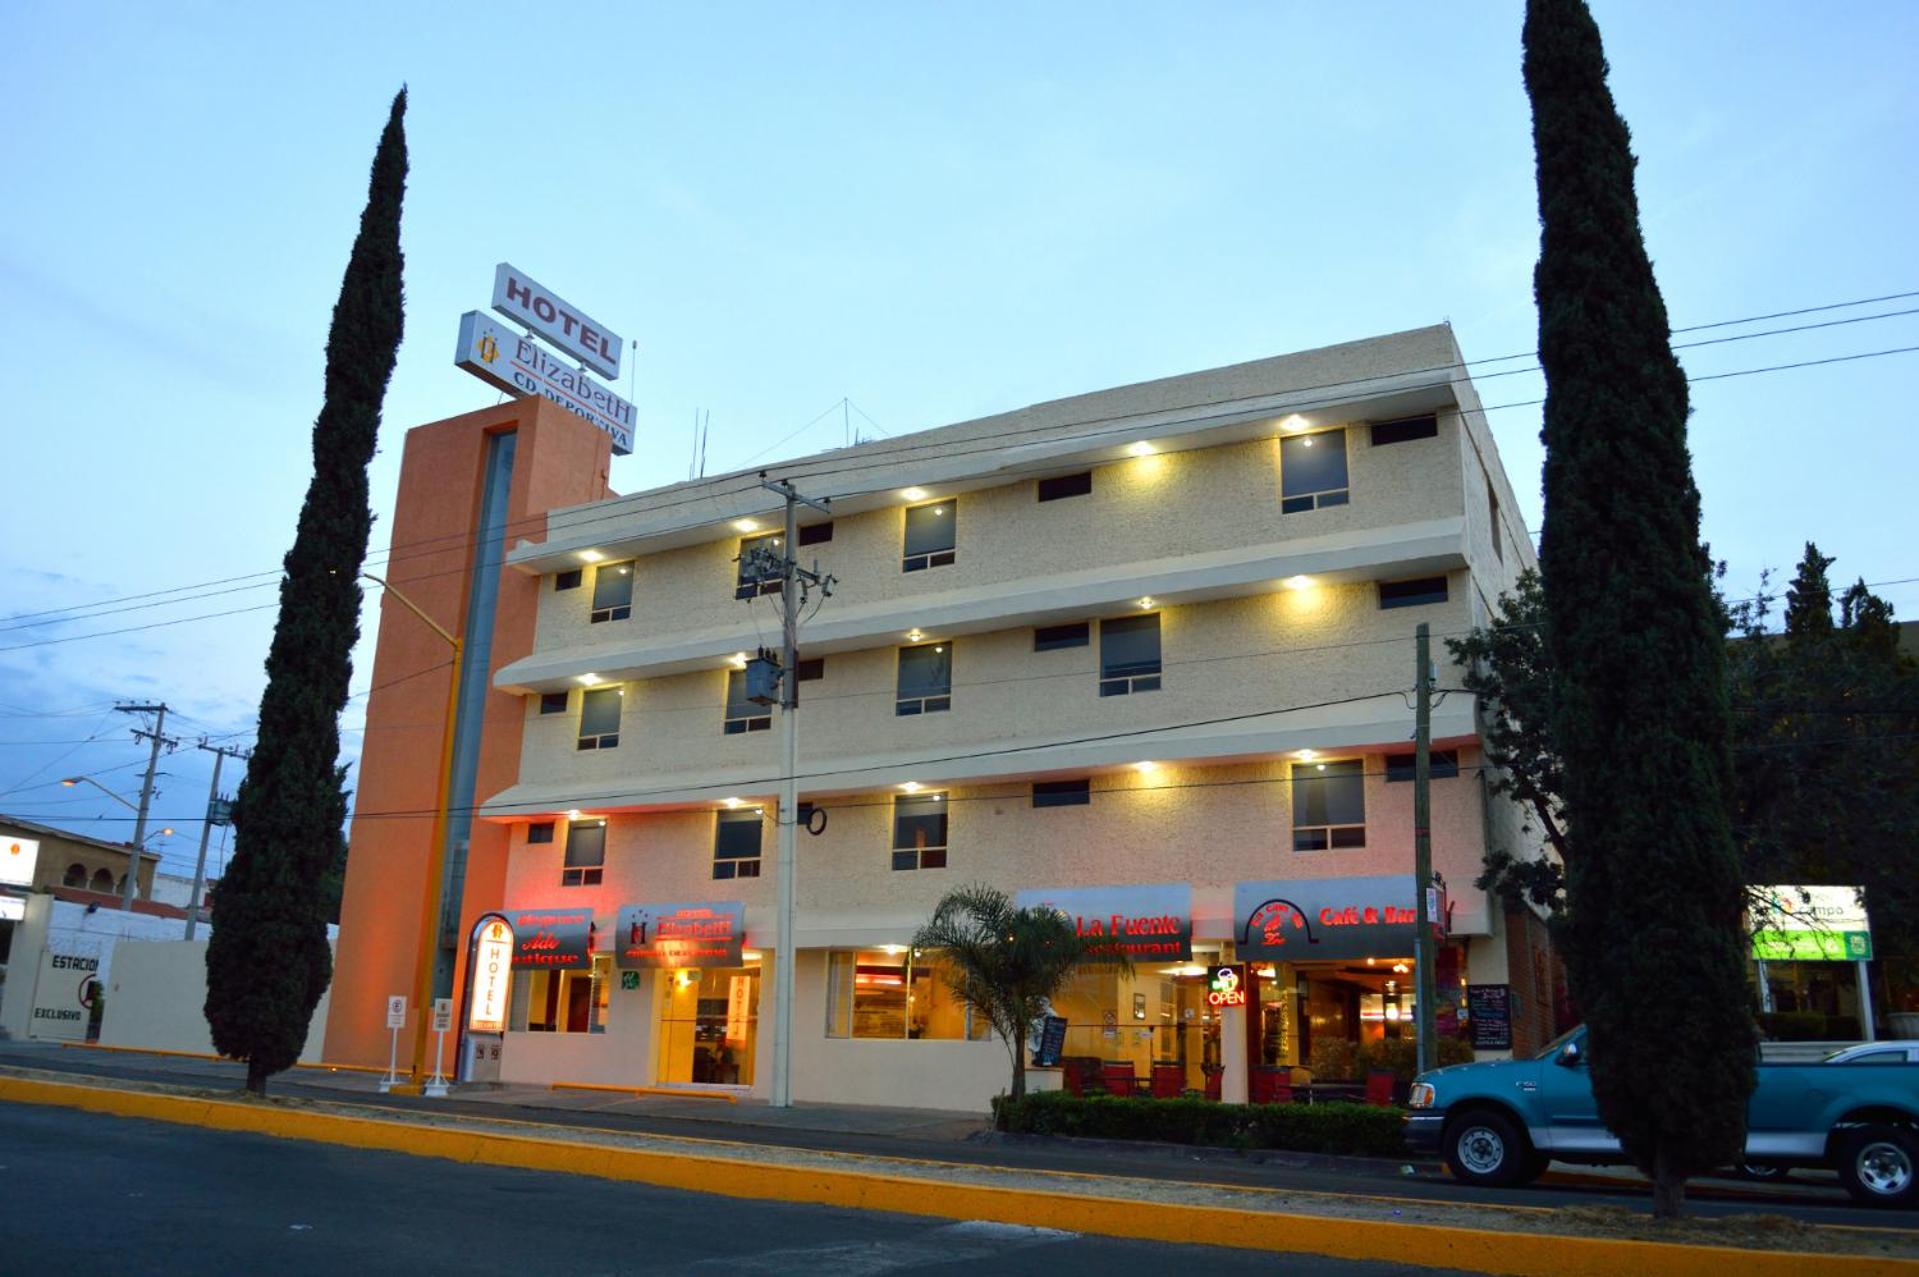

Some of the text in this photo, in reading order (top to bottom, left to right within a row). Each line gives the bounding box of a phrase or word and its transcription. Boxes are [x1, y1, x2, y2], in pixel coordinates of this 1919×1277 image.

[507, 277, 616, 365] HOTEL
[514, 371, 537, 392] CD
[1076, 914, 1182, 937] La Fuente
[1320, 905, 1360, 926] Café
[1364, 907, 1379, 924] &
[1384, 906, 1417, 924] Bar
[1076, 941, 1181, 955] staurant
[485, 947, 501, 1016] HOTEL
[1208, 990, 1245, 1005] OPEN
